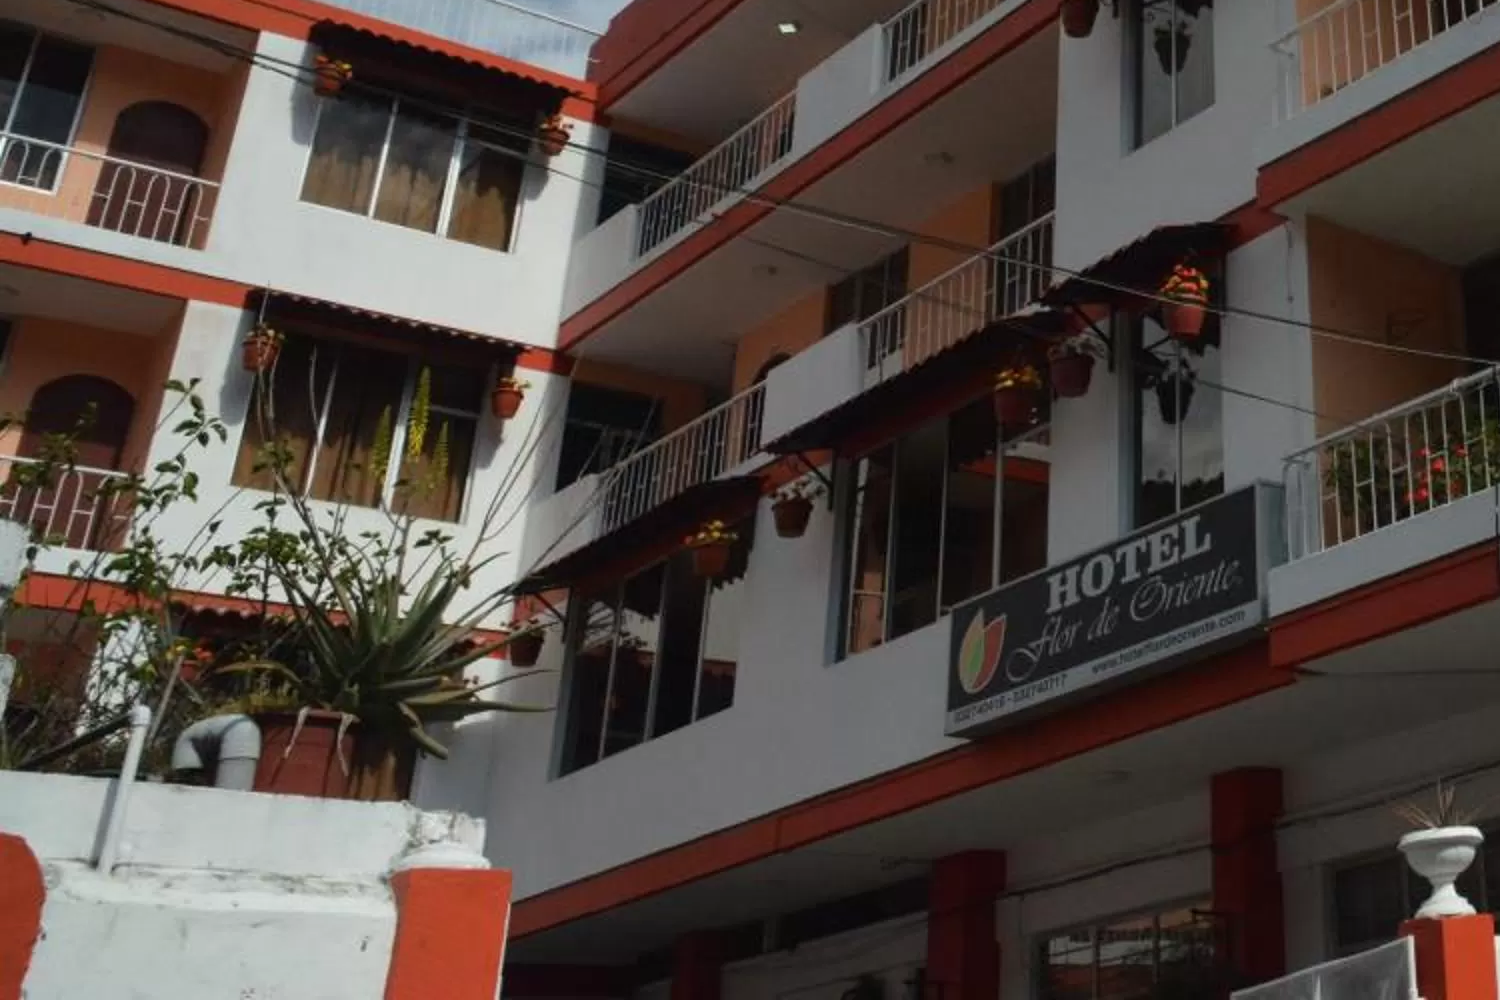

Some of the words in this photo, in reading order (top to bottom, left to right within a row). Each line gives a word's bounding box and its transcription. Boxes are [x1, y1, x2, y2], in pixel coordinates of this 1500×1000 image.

[1046, 513, 1212, 614] HOTEL
[1005, 620, 1083, 683] Flor
[1086, 596, 1121, 642] de
[1129, 558, 1244, 622] Oriente
